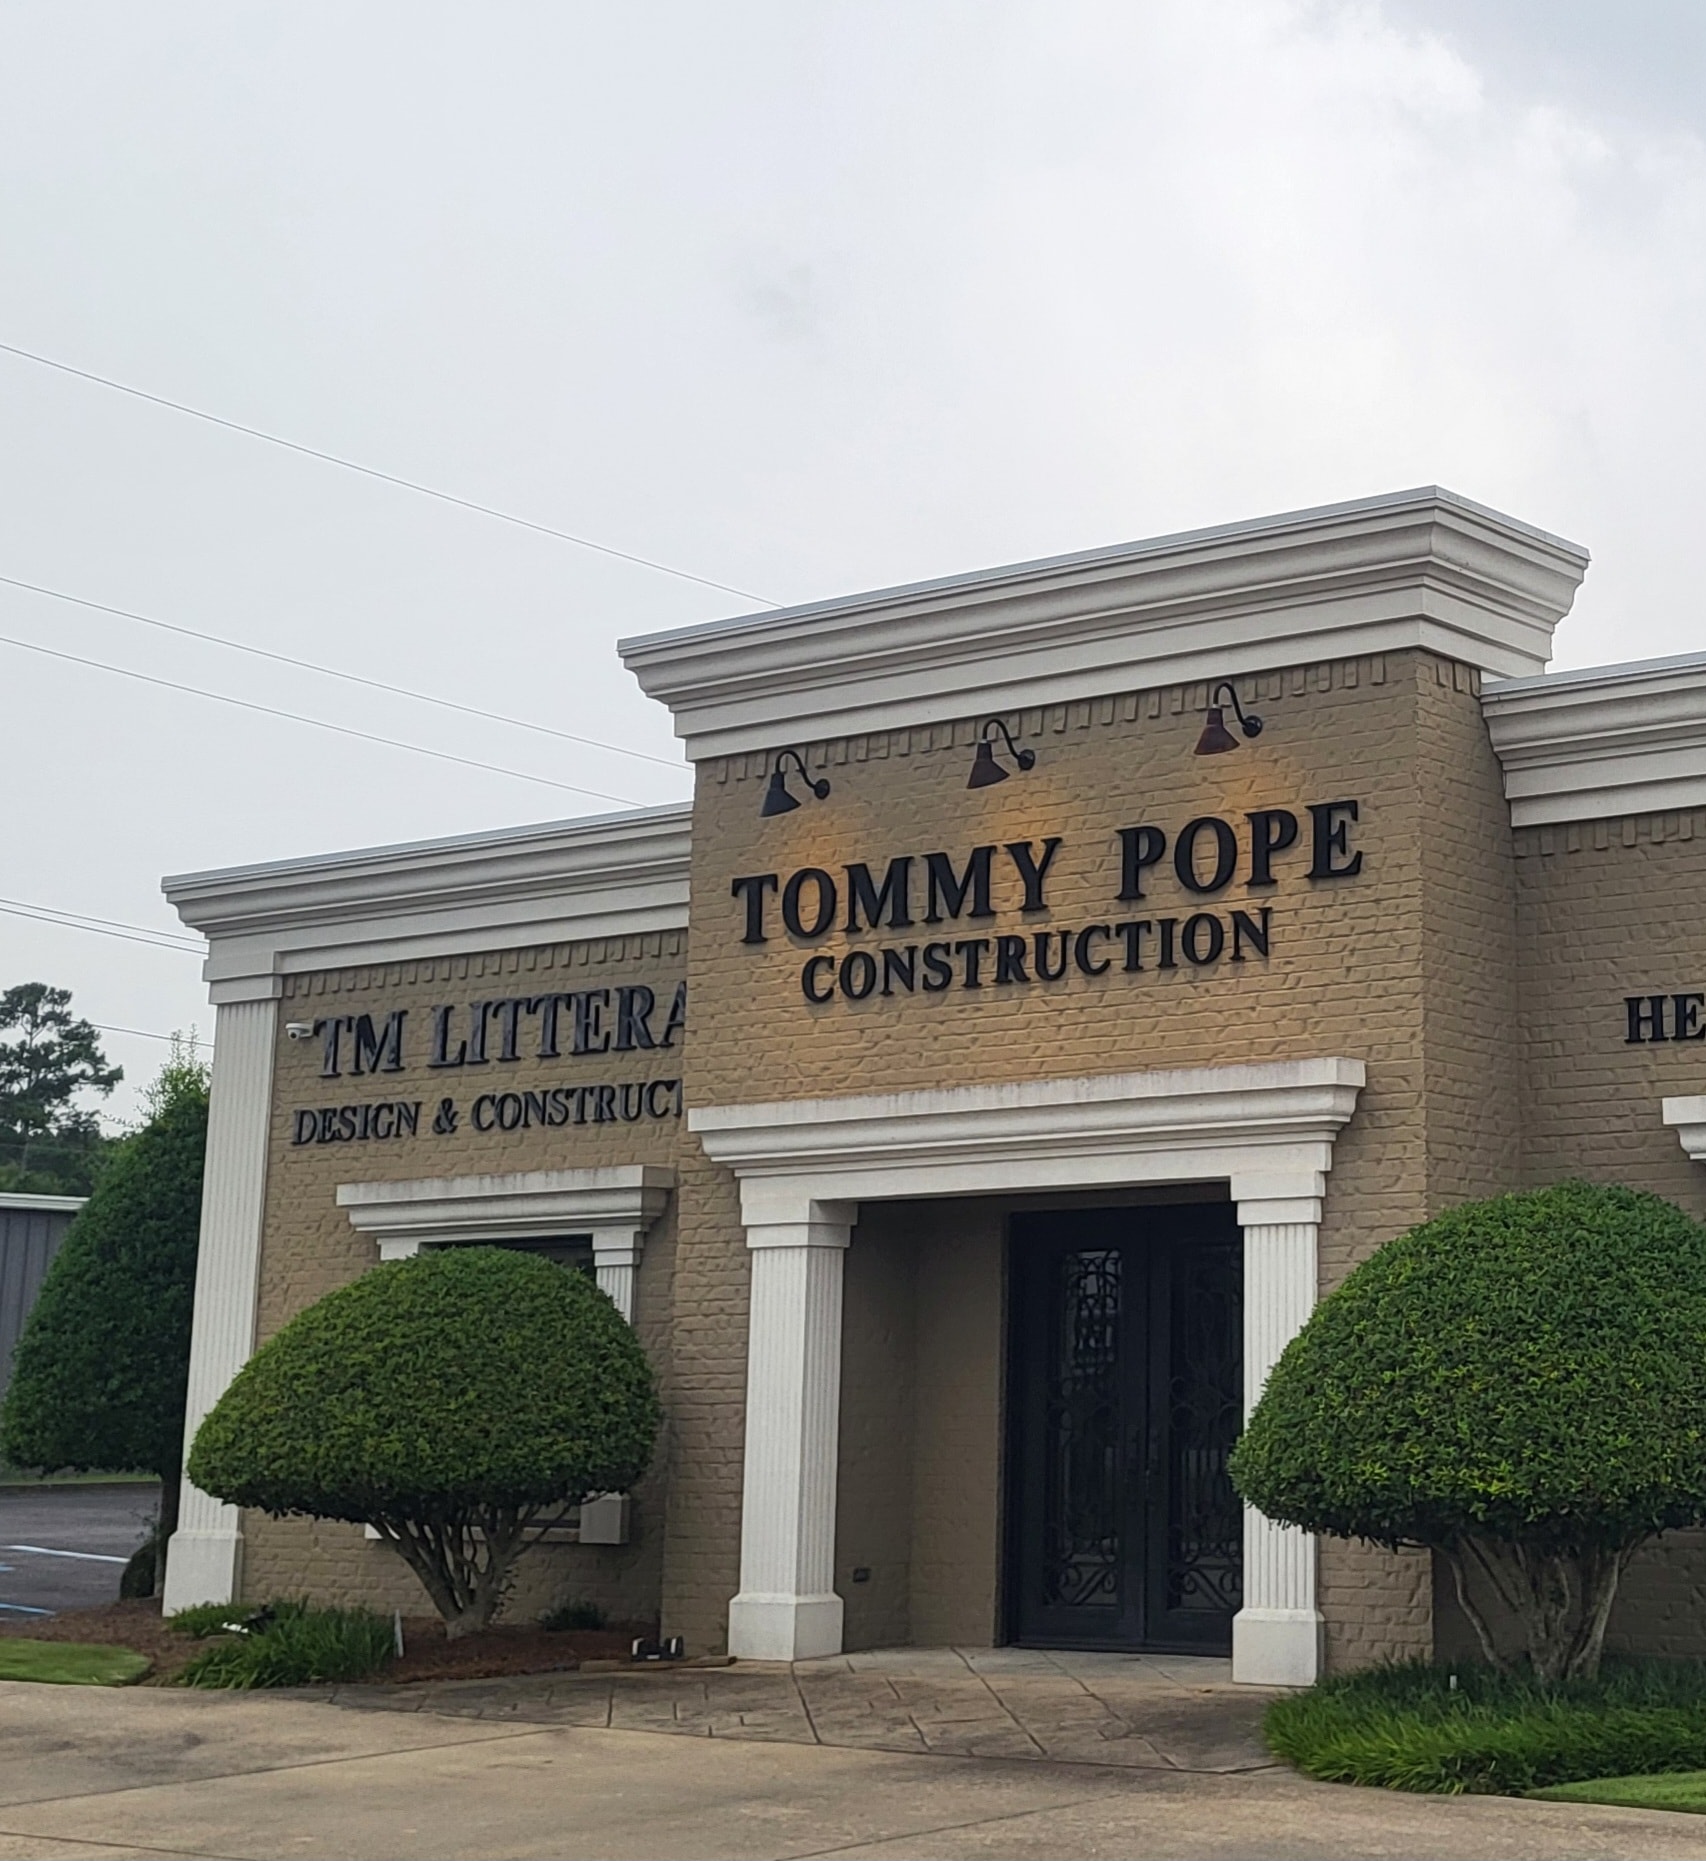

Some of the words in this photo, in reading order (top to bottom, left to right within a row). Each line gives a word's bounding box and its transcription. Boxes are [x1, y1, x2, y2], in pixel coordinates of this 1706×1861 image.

[732, 837, 1062, 944] TOMMY
[1115, 800, 1363, 900] POPE
[803, 907, 1272, 1003] CONSTRUCTION
[314, 1010, 408, 1079] TM
[291, 1101, 423, 1146] DESIGN
[432, 1098, 460, 1134] &
